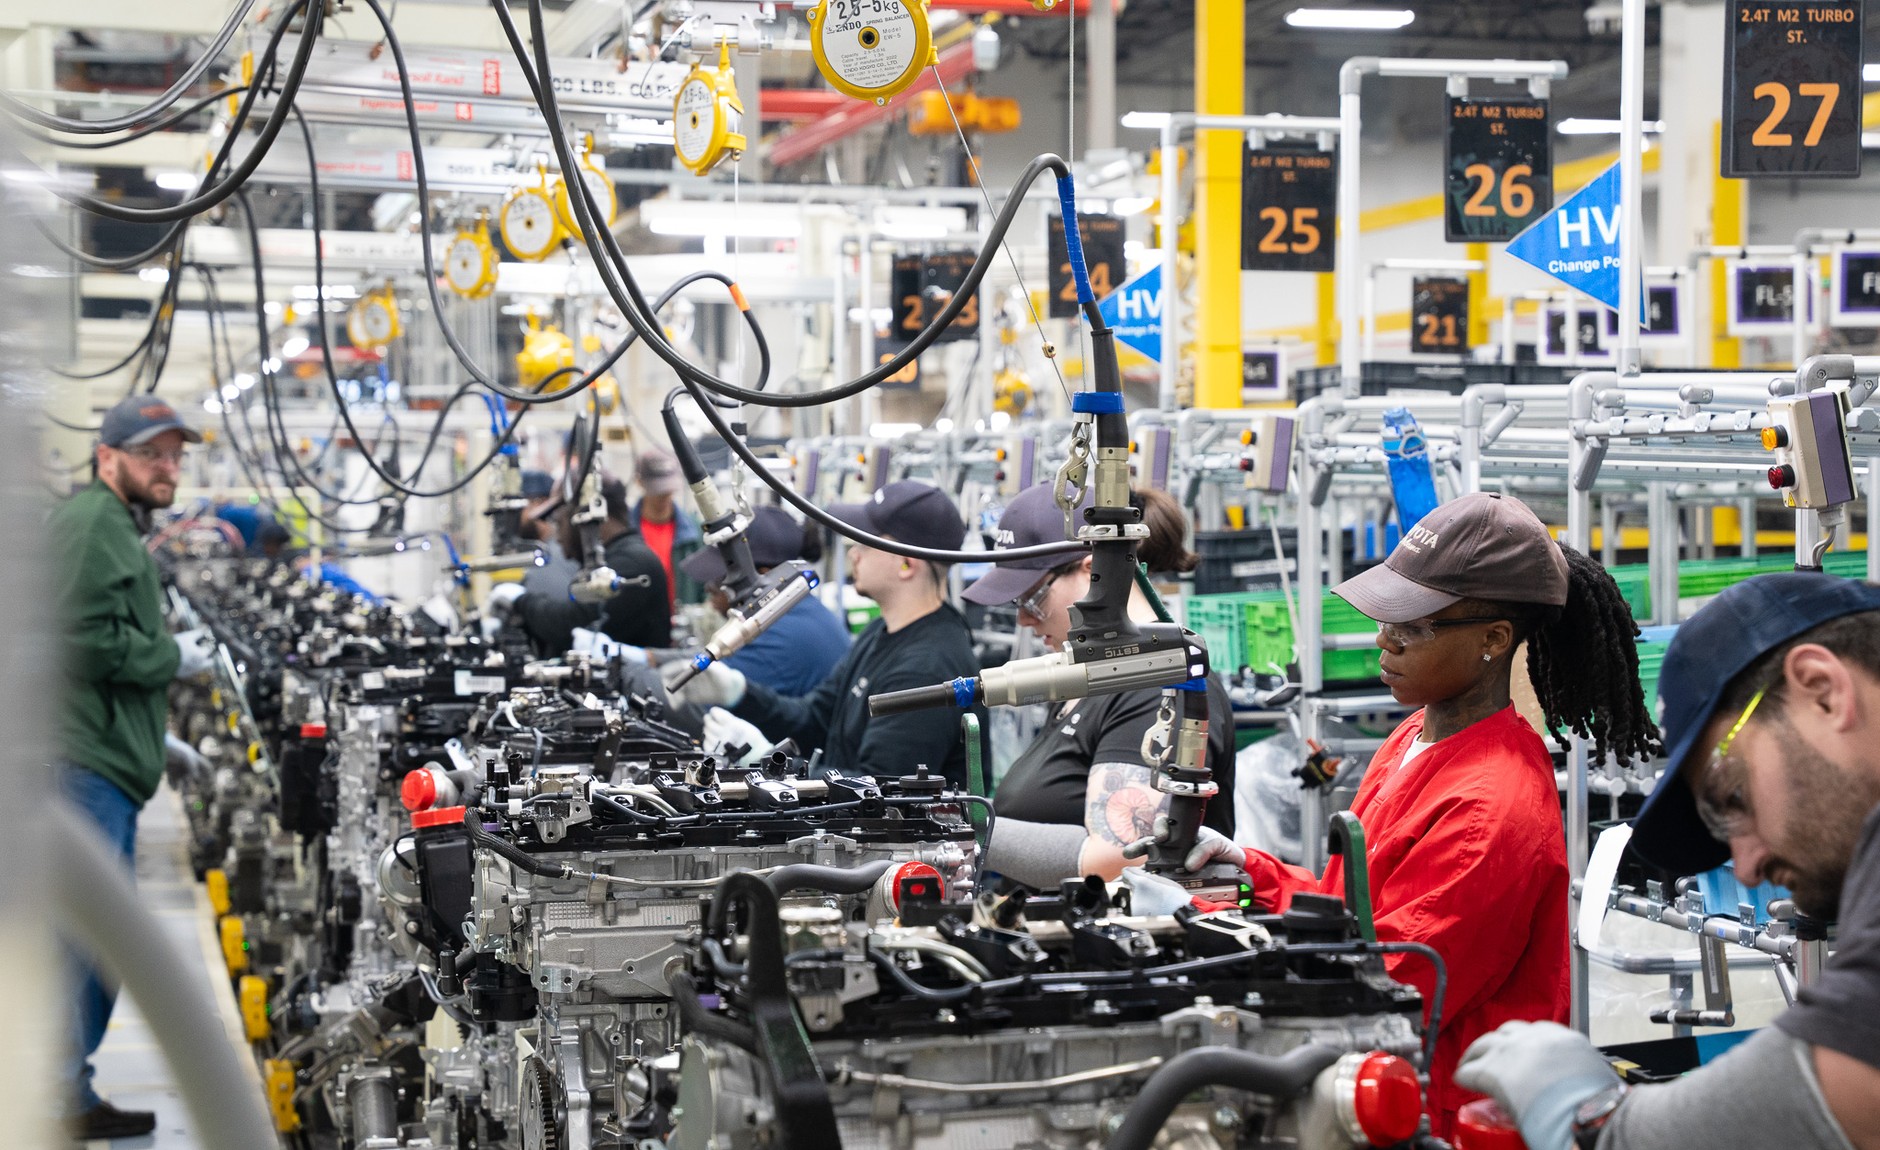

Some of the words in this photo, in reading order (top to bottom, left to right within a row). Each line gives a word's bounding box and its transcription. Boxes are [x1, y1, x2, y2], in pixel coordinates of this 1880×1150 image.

[1741, 9, 1770, 22] 2.4T
[1777, 9, 1800, 22] M2
[1806, 9, 1854, 22] TURBO
[1787, 30, 1807, 43] ST.
[550, 77, 573, 92] 00
[1482, 106, 1501, 119] M2
[1505, 106, 1545, 119] TURBO
[1752, 82, 1840, 147] 27
[1463, 164, 1534, 217] 26
[1258, 206, 1321, 254] 25
[1557, 205, 1621, 249] HV
[1548, 259, 1600, 274] Change
[1420, 313, 1460, 345] 21
[1408, 523, 1439, 549] YOTA
[1105, 646, 1140, 658] ESTIC
